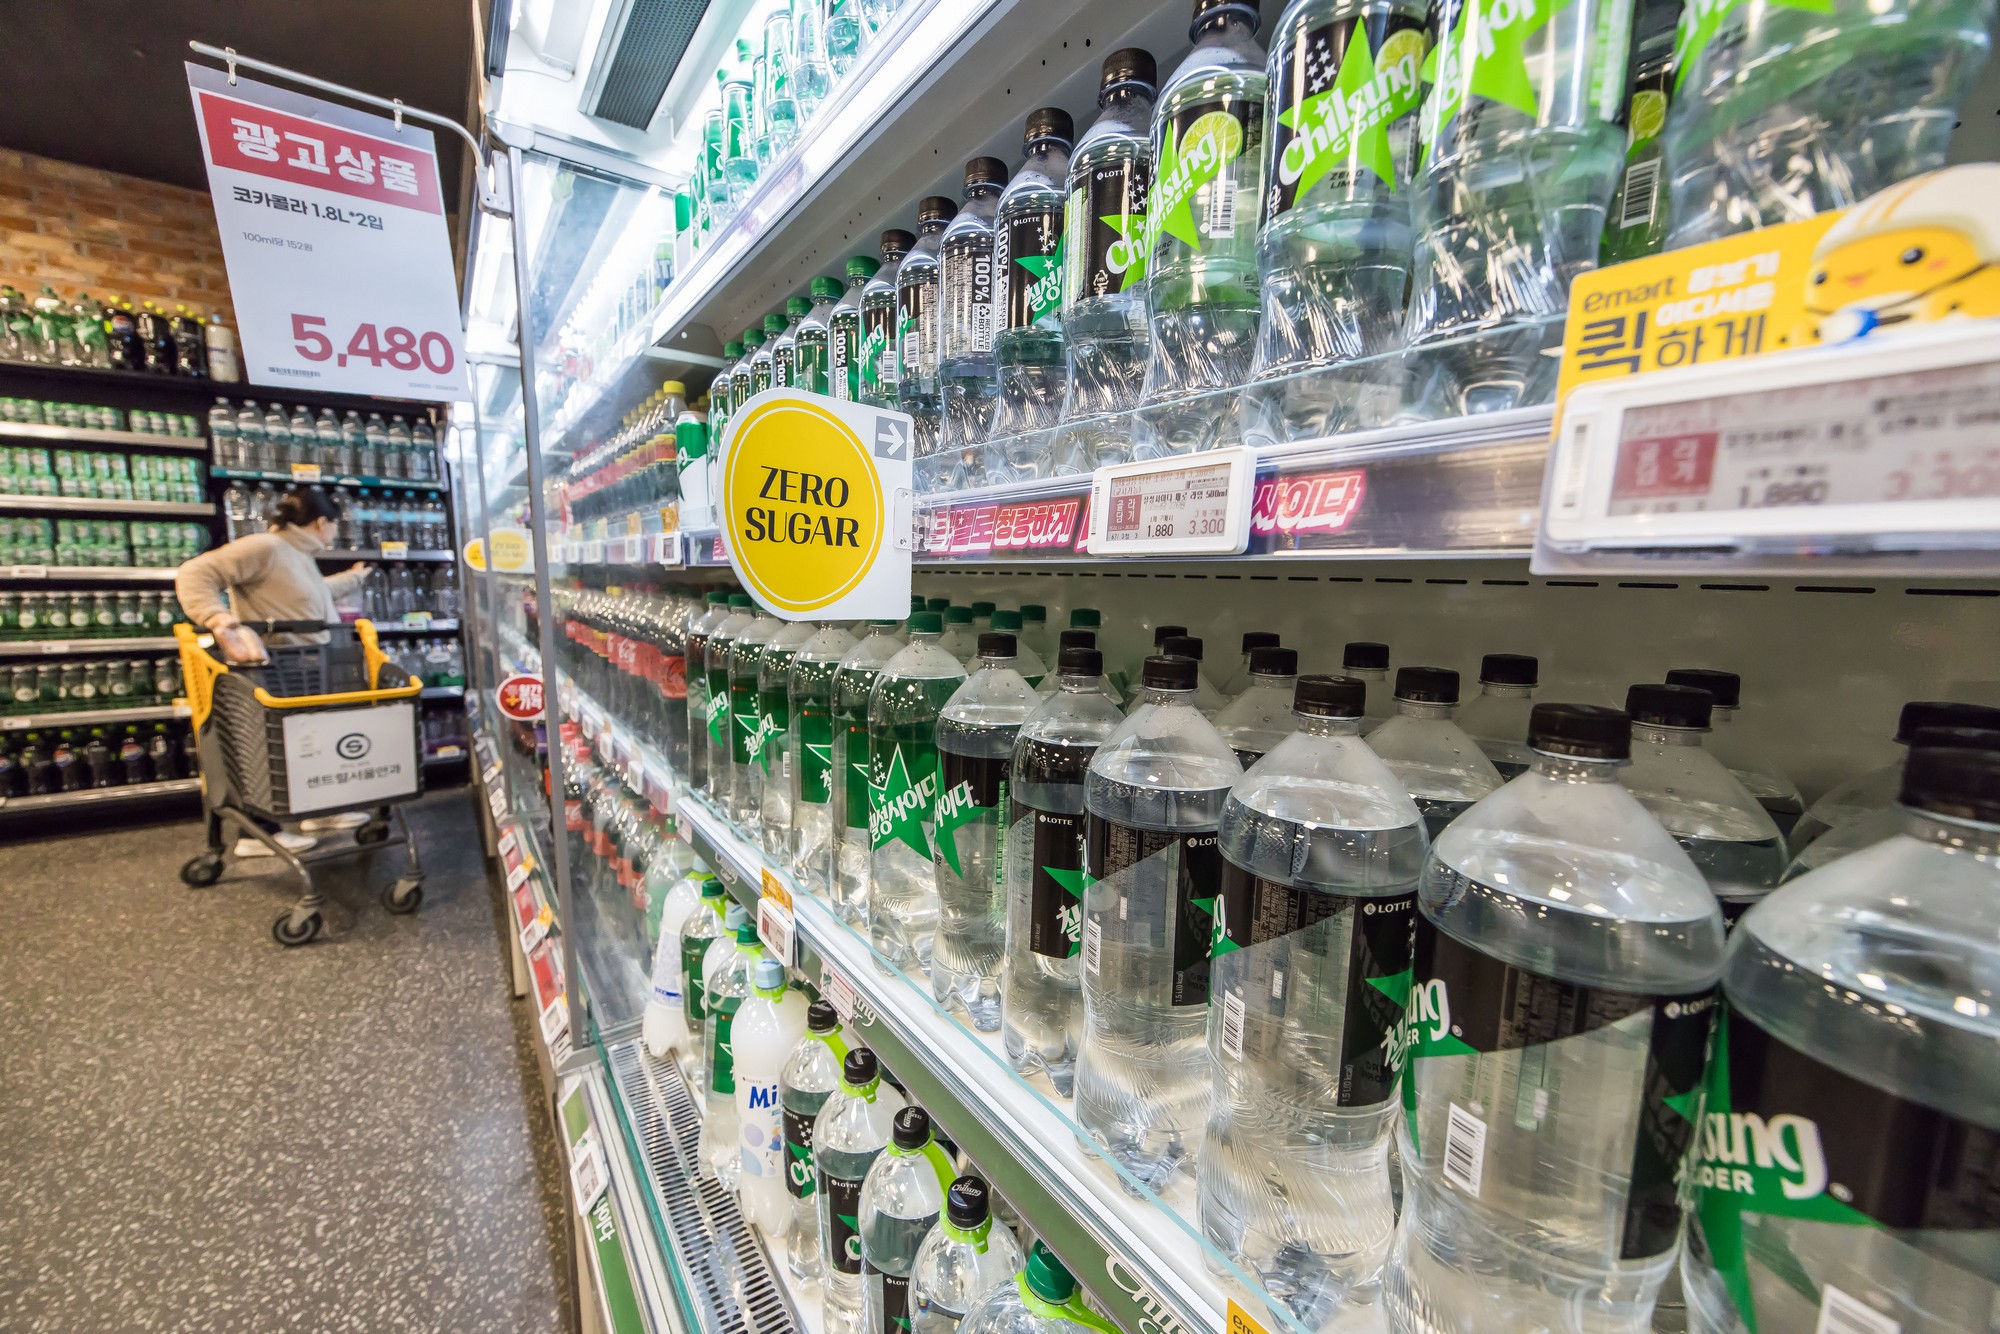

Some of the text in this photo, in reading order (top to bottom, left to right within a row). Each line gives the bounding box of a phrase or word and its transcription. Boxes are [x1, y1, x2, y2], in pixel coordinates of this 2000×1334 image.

[1279, 54, 1417, 186] Chilsung
[231, 117, 419, 197] 광고상품
[1104, 169, 1125, 178] LOTT
[1330, 169, 1364, 181] ZEO
[232, 186, 308, 215] 코카콜라
[1155, 178, 1194, 232] CIDER
[1020, 216, 1040, 224] LOTTE
[975, 254, 990, 301] 100%
[1584, 276, 1676, 313] emart
[291, 313, 454, 375] 5,480
[837, 330, 846, 366] 100%
[759, 465, 849, 508] ZERO
[1250, 475, 1361, 531] 사이다
[745, 507, 860, 548] SUGAR
[994, 502, 1079, 546] 청량하게
[1189, 518, 1225, 535] 3.300
[1047, 816, 1073, 826] LOTTE
[1199, 837, 1217, 846] LOT
[1378, 900, 1412, 914] LOTTE
[749, 1084, 780, 1108] Mi
[1702, 1112, 1828, 1200] sung
[1700, 1168, 1756, 1195] DER
